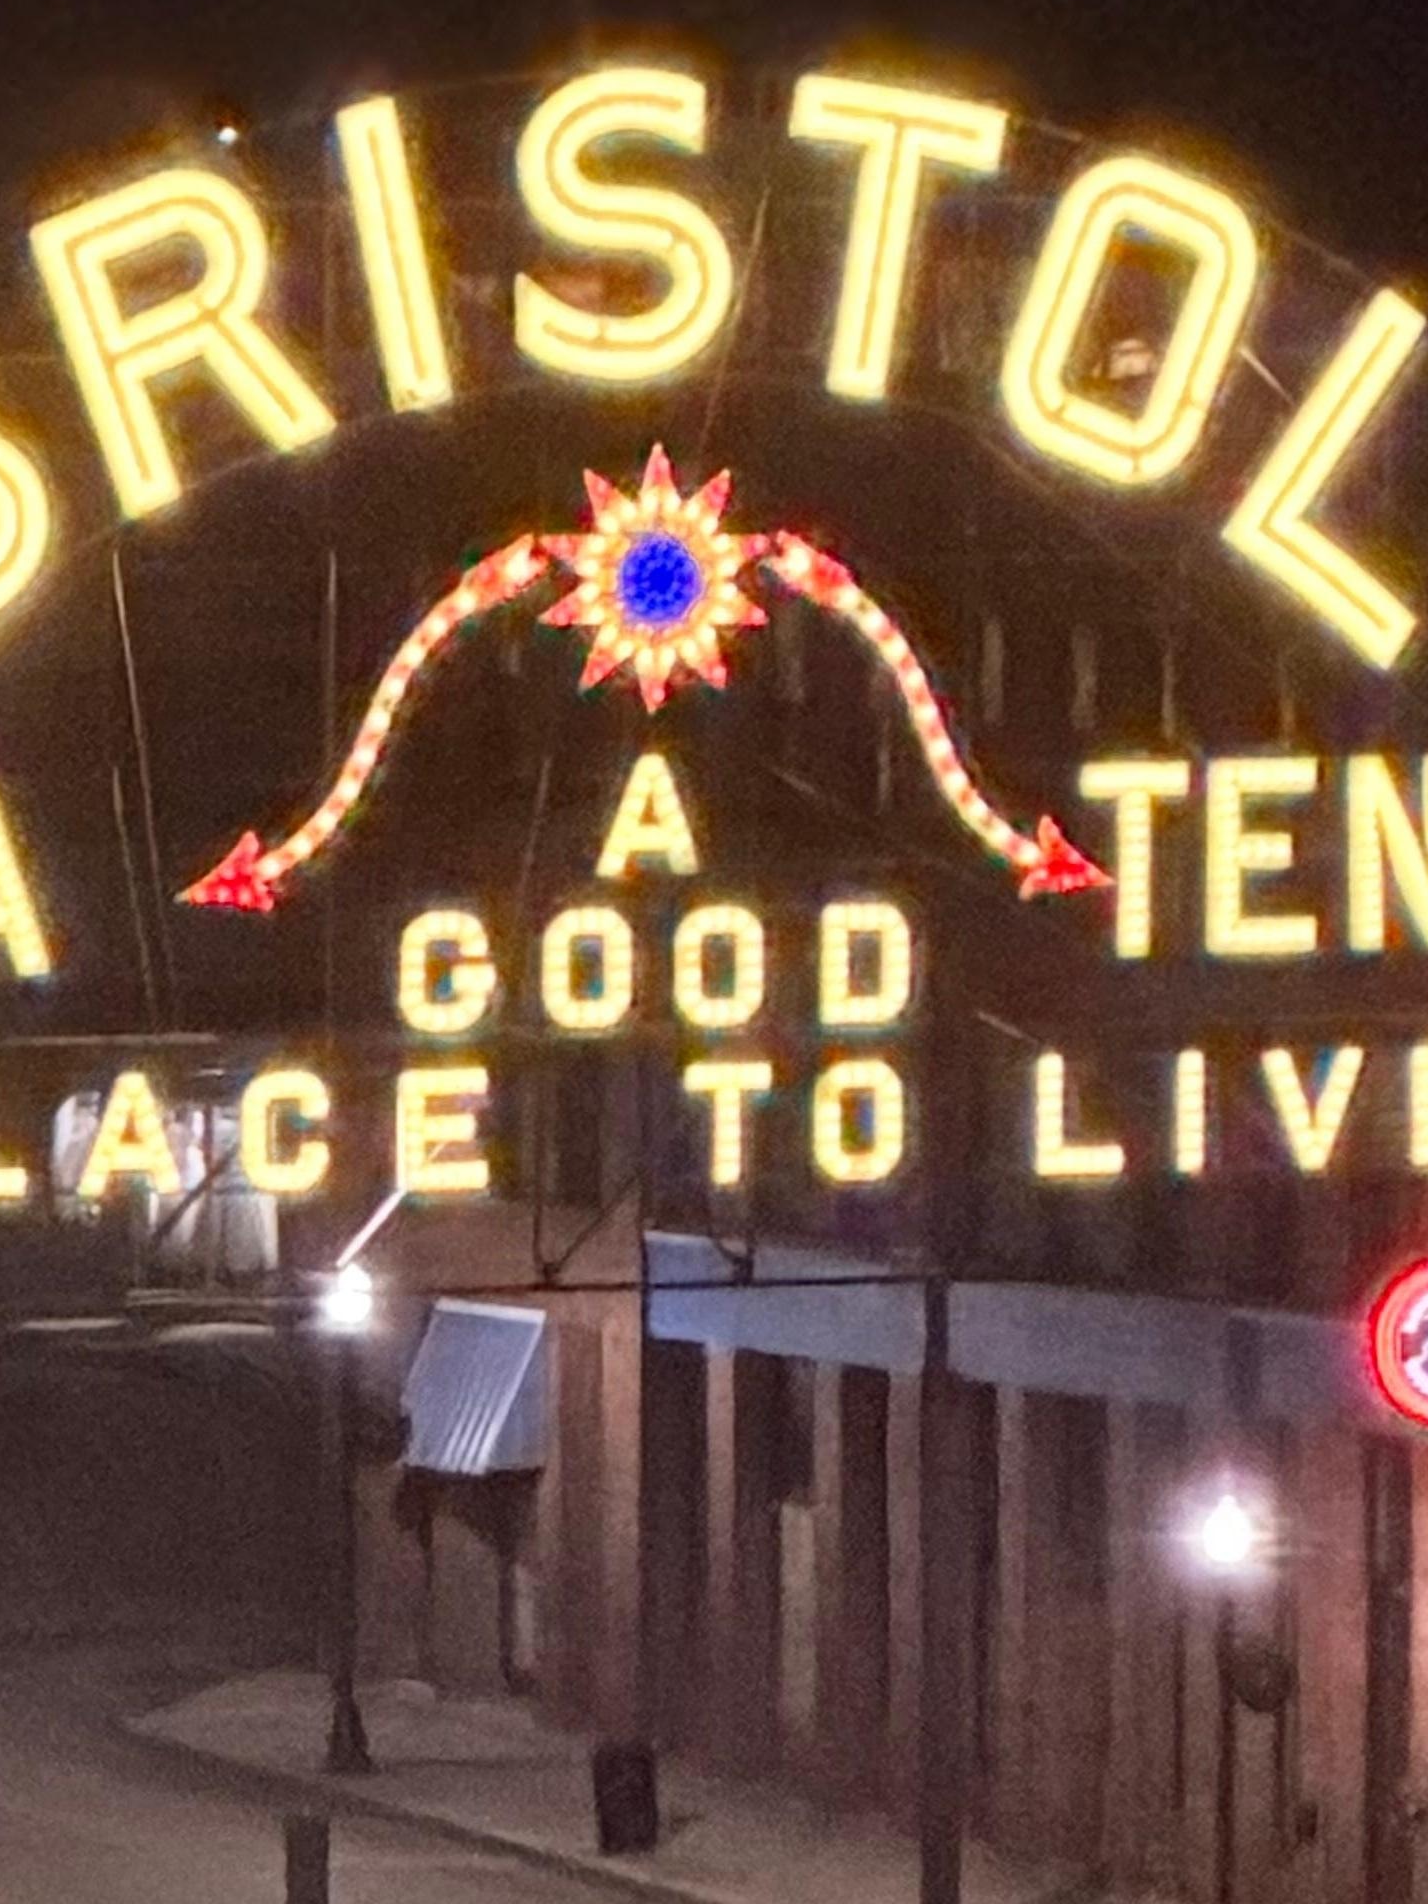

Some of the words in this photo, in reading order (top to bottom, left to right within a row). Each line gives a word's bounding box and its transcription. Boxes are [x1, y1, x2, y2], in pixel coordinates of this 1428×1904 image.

[597, 753, 697, 878] A
[398, 902, 911, 1034] GOOD
[683, 1058, 904, 1185] TO
